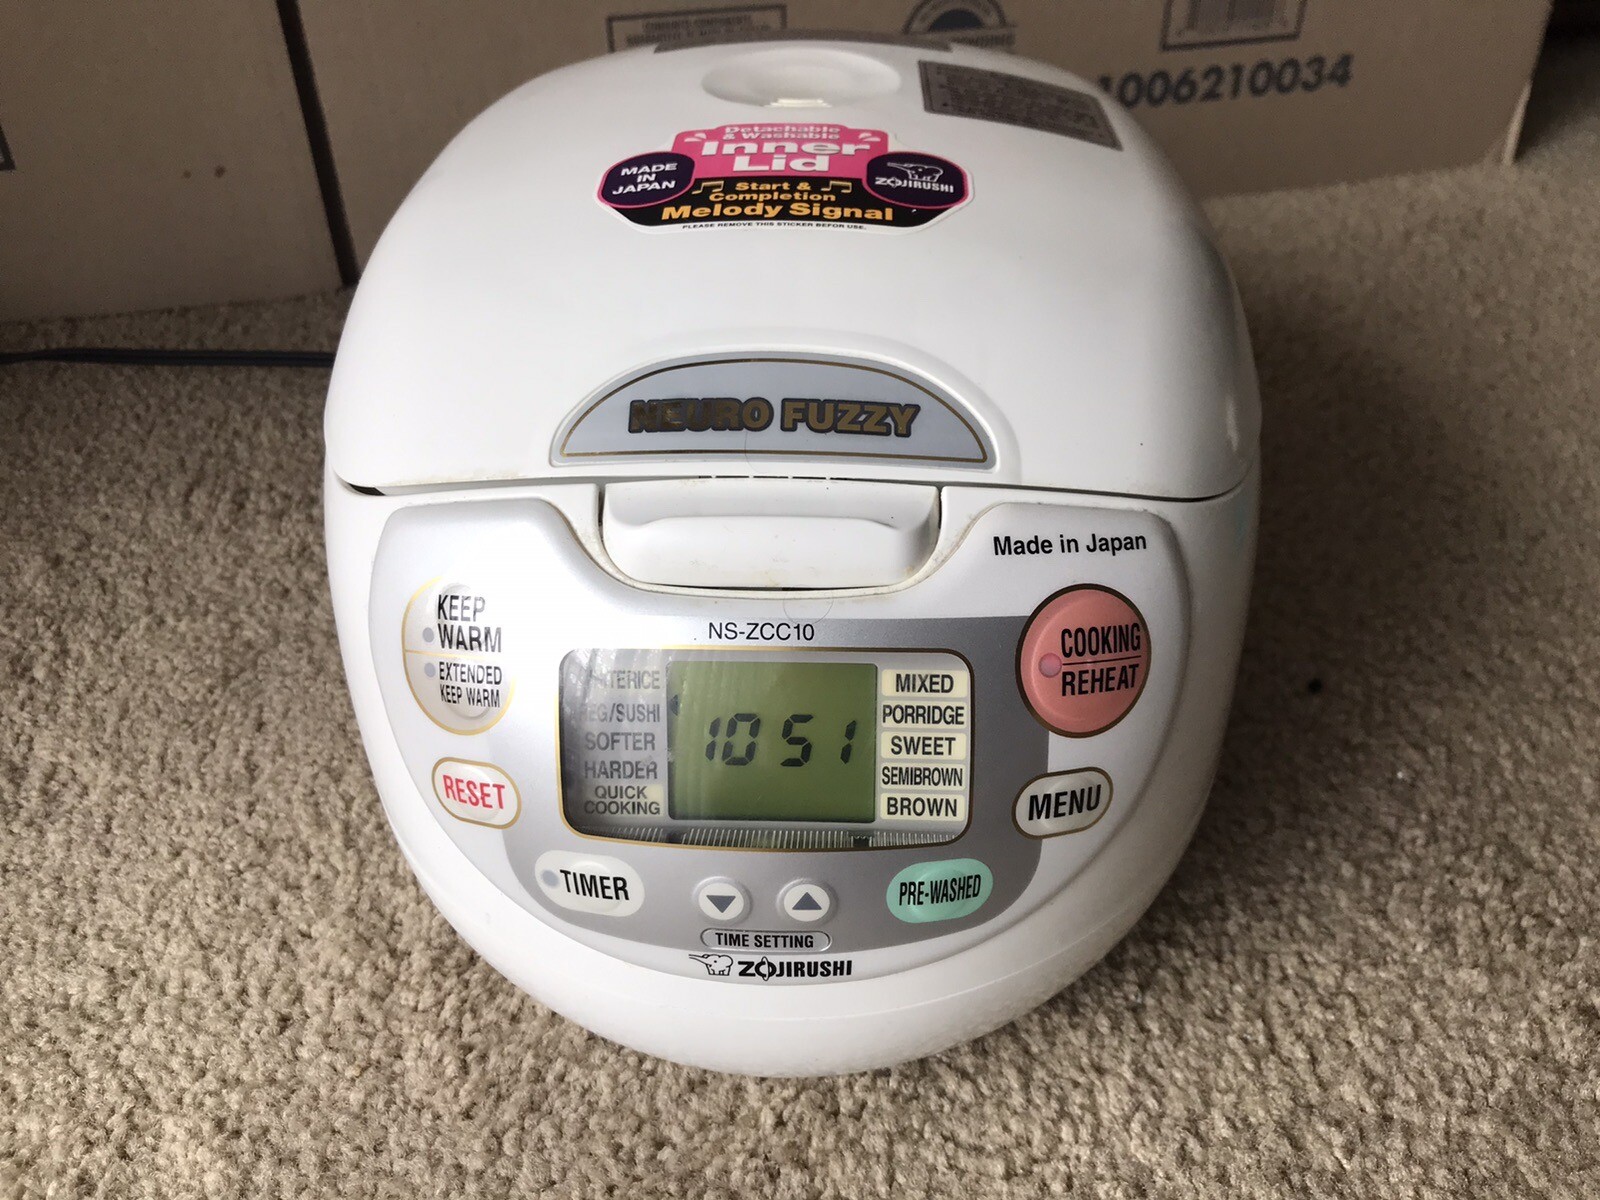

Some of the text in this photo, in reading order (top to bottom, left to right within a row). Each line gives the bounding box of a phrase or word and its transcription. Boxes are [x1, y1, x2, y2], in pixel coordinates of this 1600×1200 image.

[722, 132, 840, 140] & Washable
[724, 126, 840, 134] Detachable
[702, 141, 871, 156] Inner
[621, 162, 678, 176] MADE
[733, 154, 830, 172] Lid
[612, 180, 676, 195] JAPAN
[637, 173, 656, 183] IN
[735, 181, 812, 191] Start &
[875, 177, 955, 194] ZOJIRUSHI
[709, 191, 837, 202] Completion
[661, 202, 894, 221] Melody Signal
[628, 397, 921, 437] NEURO FUZZY
[993, 533, 1147, 556] Made in Japan
[437, 594, 486, 622] KEEP
[437, 623, 502, 653] WARM
[709, 622, 815, 641] NS-ZCC10
[1060, 622, 1142, 658] COOKING
[439, 661, 502, 685] EXTENDED
[1061, 663, 1140, 696] REHEAT
[895, 673, 955, 694] MIXED
[440, 684, 501, 709] KEEP WARM
[582, 702, 661, 722] EG/SUSHI
[882, 704, 965, 726] PORRIDGE
[584, 731, 655, 751] SOFTER
[890, 736, 956, 757] SWEET
[584, 760, 658, 780] HARDER
[881, 766, 964, 788] SEMIBROWN
[443, 774, 505, 810] RESET
[595, 785, 647, 800] QUICK
[584, 800, 661, 816] COOKING
[886, 797, 958, 818] BROWN
[1028, 784, 1102, 821] MENU
[560, 869, 630, 901] TIMER
[899, 873, 983, 907] PRE-WASHED
[715, 932, 814, 949] TIME SETTING
[737, 956, 853, 981] ZOJIRUSHI
